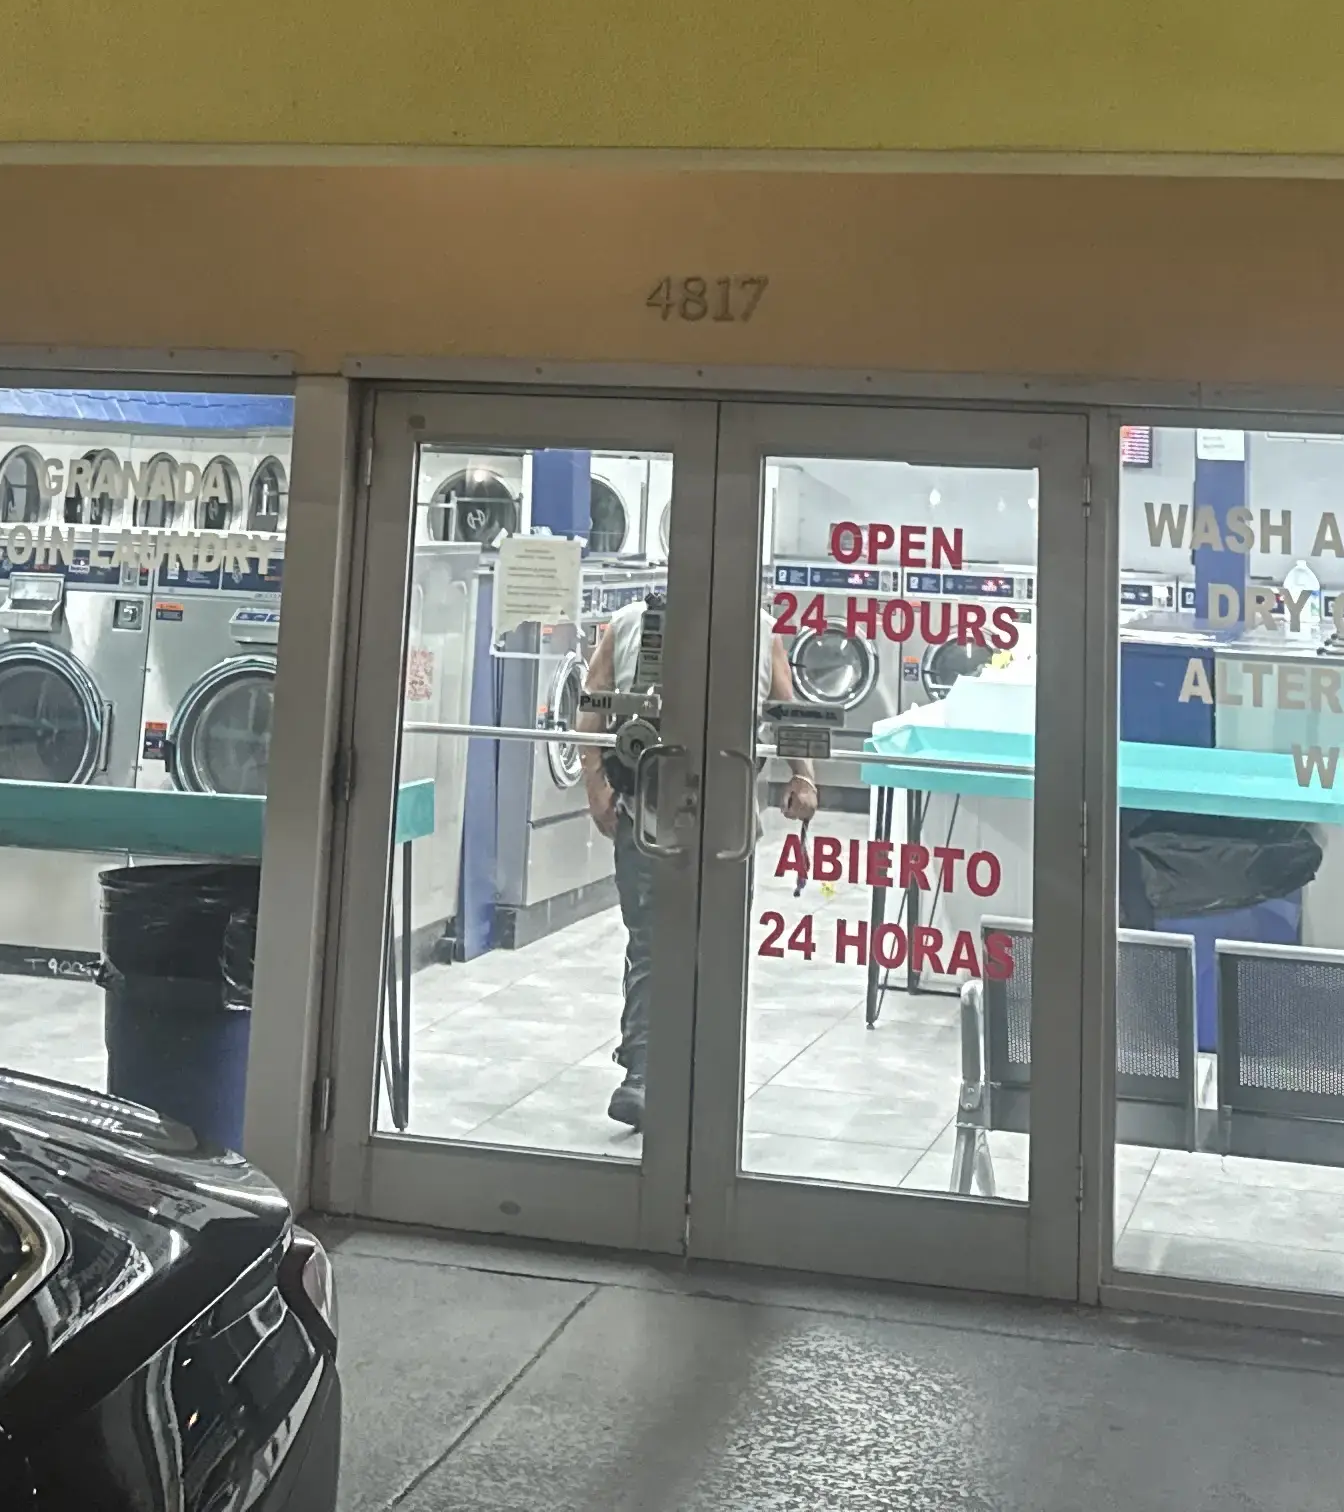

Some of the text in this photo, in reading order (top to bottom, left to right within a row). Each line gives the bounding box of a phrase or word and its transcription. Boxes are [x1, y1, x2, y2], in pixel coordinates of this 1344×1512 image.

[646, 276, 770, 322] 4817
[43, 458, 228, 504] GRANADA
[90, 527, 279, 575] LAUNDRY
[830, 521, 964, 570] OPEN
[1144, 502, 1293, 555] WASH
[772, 592, 1019, 651] 24 HOURS
[1208, 583, 1312, 634] DRY
[580, 695, 612, 709] Pull
[774, 833, 1001, 898] ABIERTO
[758, 911, 1016, 981] 24 HORAS
